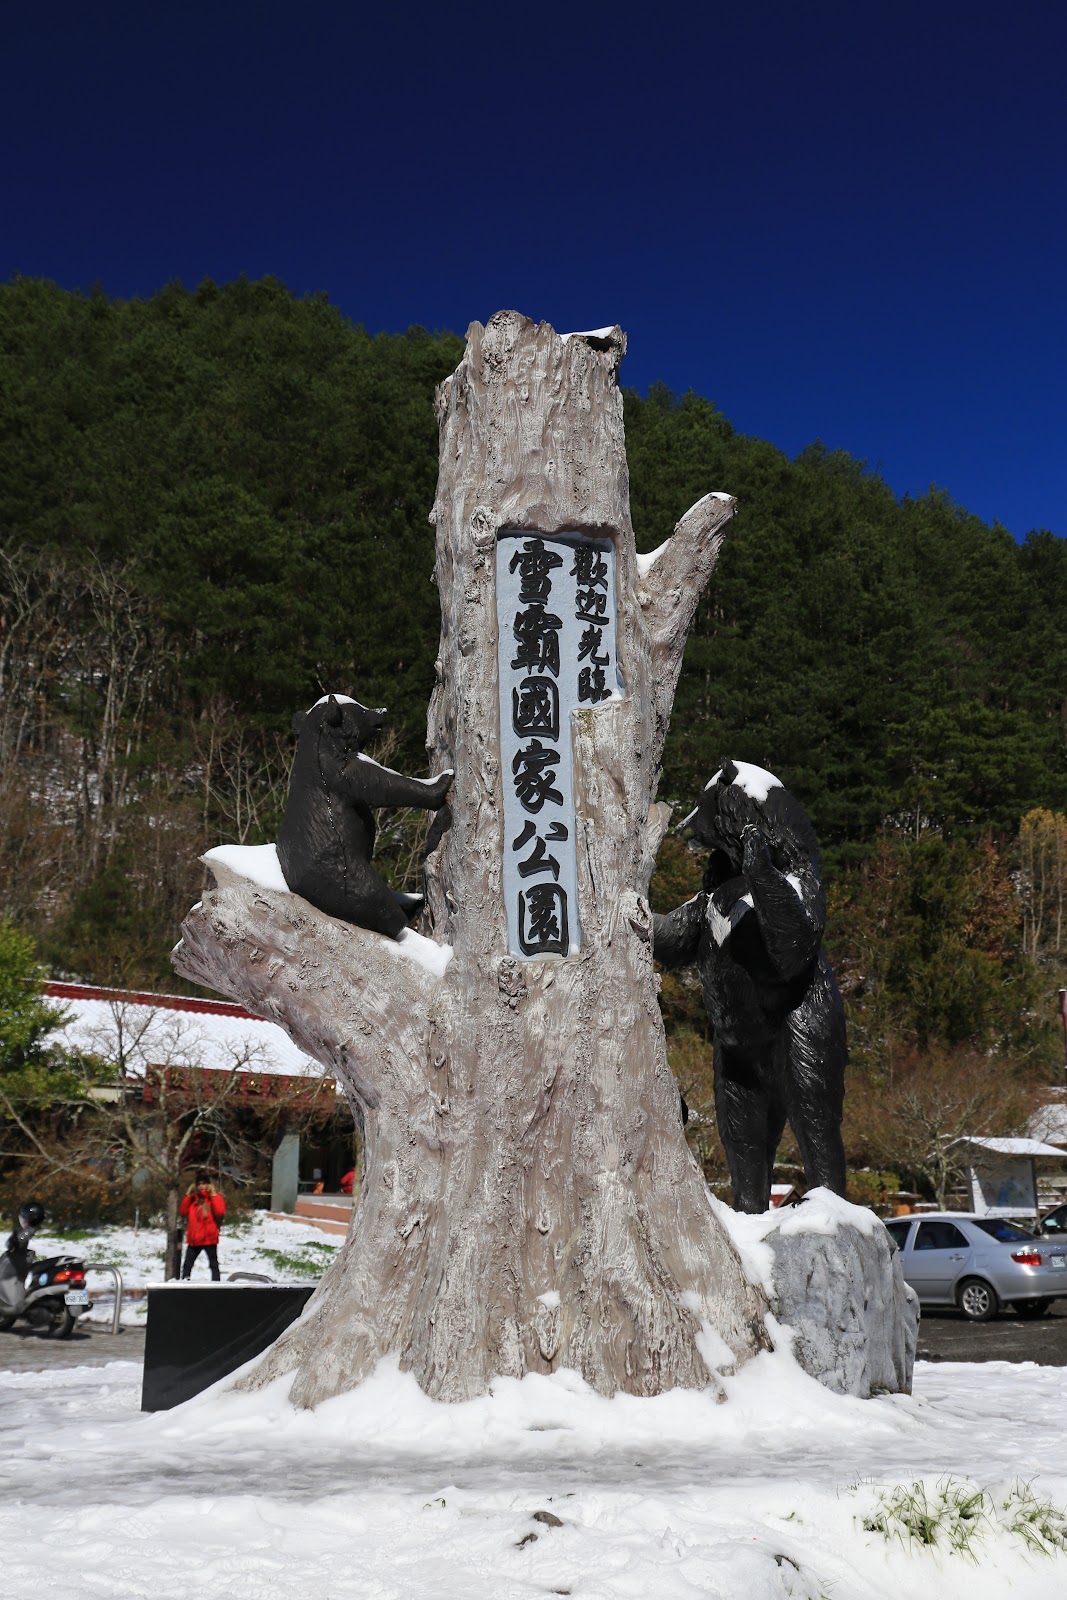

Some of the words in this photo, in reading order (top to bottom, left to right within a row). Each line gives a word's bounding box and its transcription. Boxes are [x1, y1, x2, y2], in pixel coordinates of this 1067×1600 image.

[509, 540, 568, 957] 雪霸國家公園
